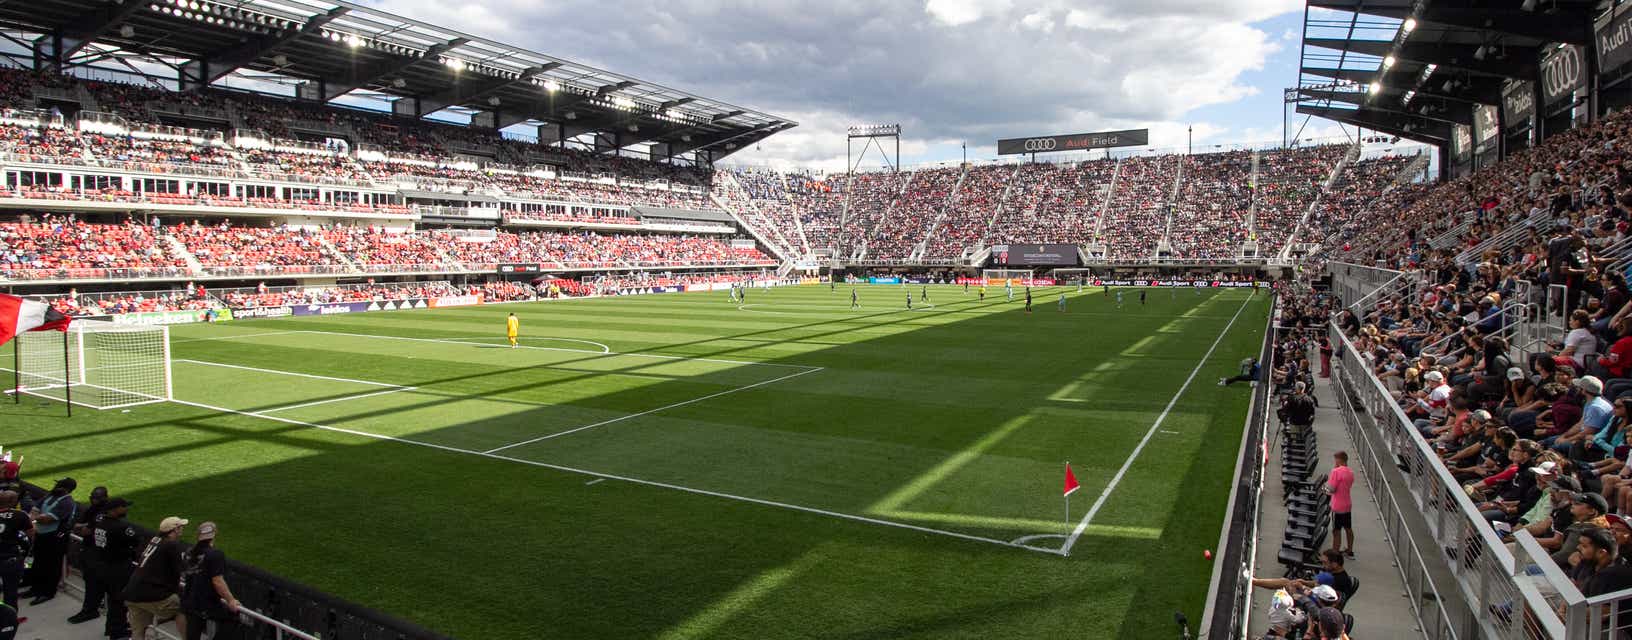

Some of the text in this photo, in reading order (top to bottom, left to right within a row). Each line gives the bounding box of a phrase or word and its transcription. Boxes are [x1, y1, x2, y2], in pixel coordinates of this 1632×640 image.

[1601, 22, 1628, 55] Audi
[1065, 136, 1118, 148] Audi Field
[233, 306, 293, 318] sport&health
[321, 305, 351, 314] leidos
